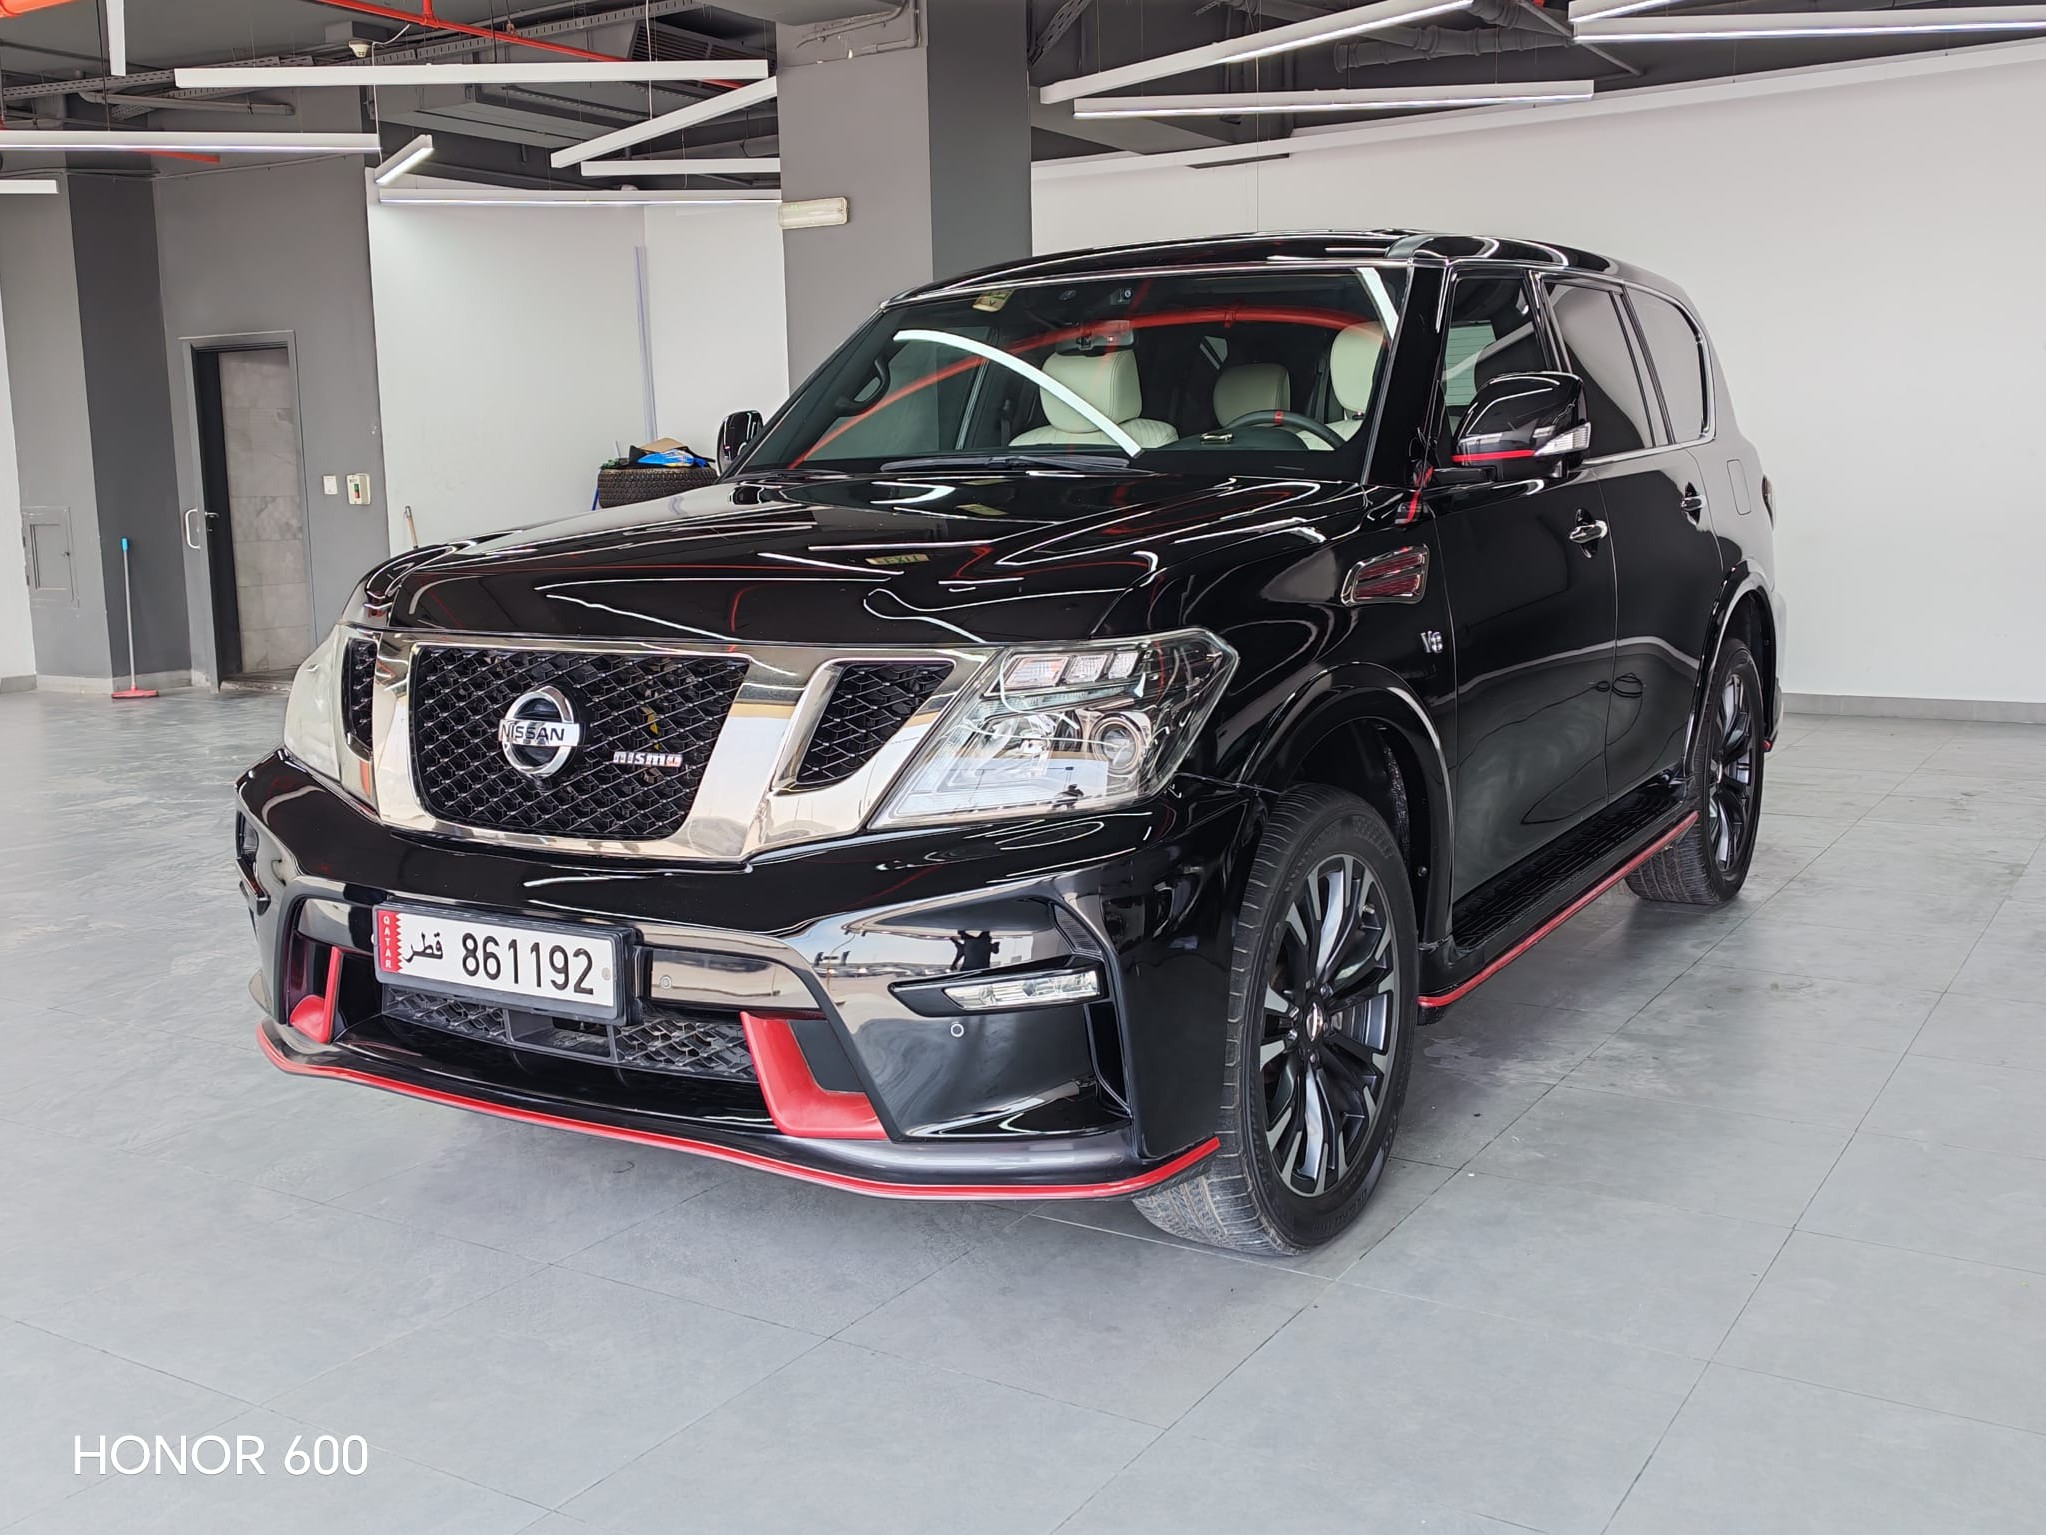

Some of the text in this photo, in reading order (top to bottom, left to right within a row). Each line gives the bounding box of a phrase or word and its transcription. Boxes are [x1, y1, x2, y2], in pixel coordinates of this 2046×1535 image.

[500, 727, 565, 742] NISSAN
[383, 915, 392, 969] QATAR
[403, 931, 444, 963] قطر
[461, 932, 594, 995] 861192
